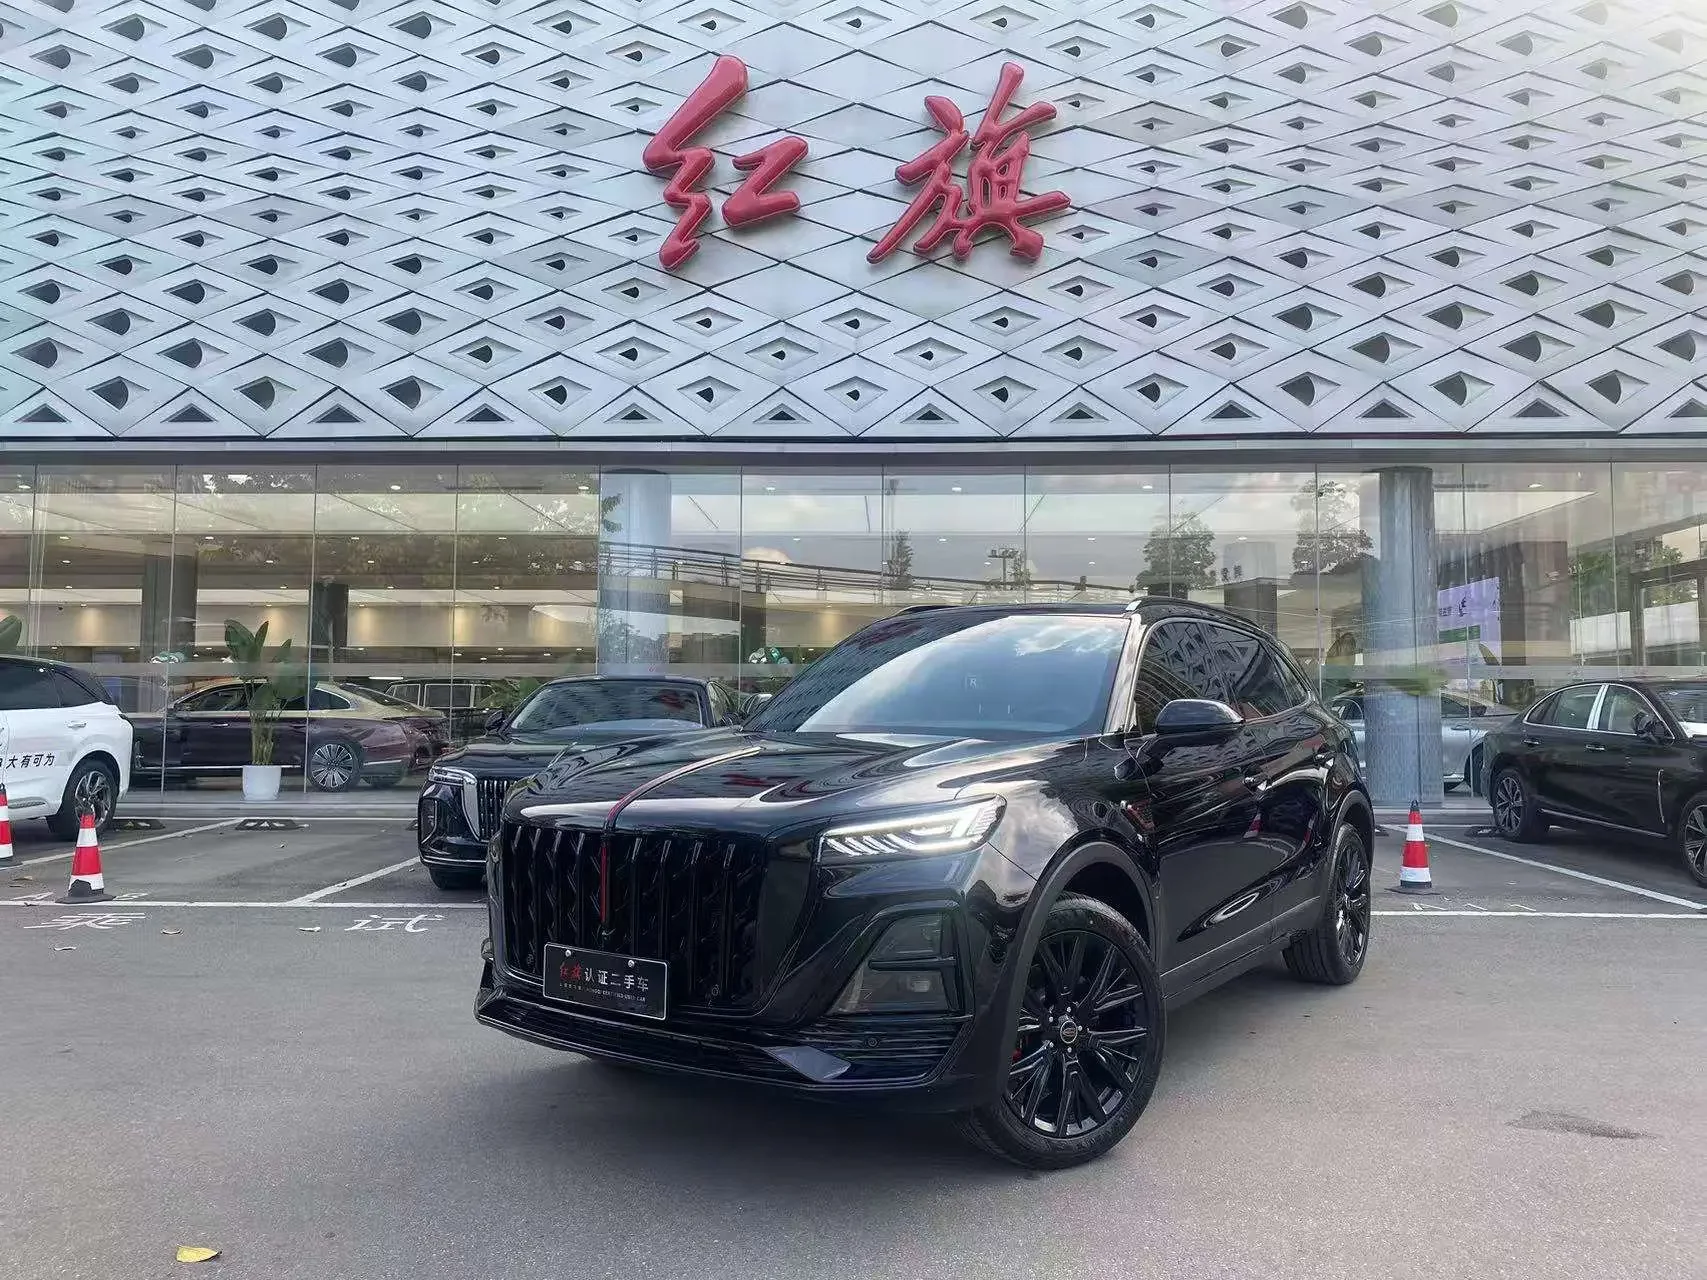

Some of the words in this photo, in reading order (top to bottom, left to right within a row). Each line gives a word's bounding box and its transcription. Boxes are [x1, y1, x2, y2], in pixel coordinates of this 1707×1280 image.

[642, 54, 1071, 272] 红旗
[0, 753, 55, 769] 大有可为
[584, 967, 649, 992] 认证二手车
